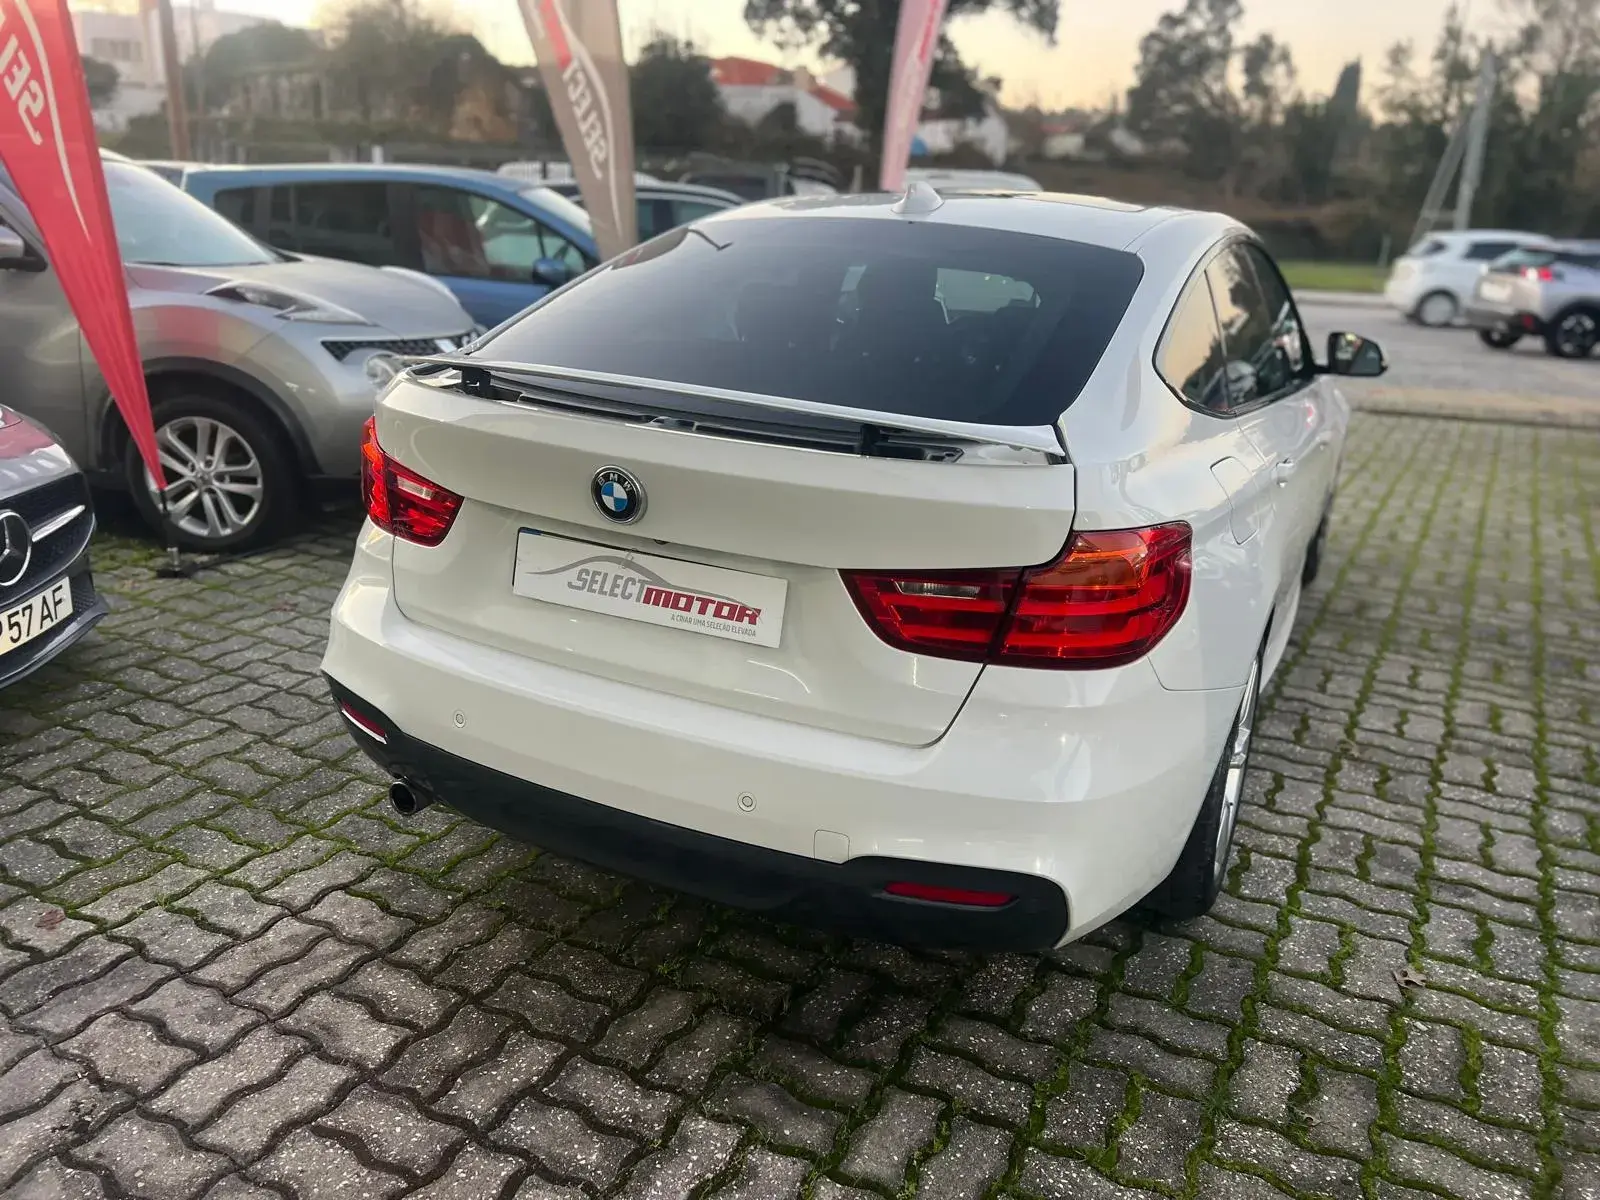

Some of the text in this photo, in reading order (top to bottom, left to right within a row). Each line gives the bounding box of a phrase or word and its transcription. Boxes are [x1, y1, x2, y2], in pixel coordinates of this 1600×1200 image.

[597, 472, 633, 492] BMW
[7, 603, 33, 644] 57
[40, 584, 63, 630] AF
[676, 614, 692, 624] CRIAR
[692, 618, 706, 628] UMA
[706, 620, 731, 632] SELEÇÃO
[731, 625, 756, 637] ELEVADA
